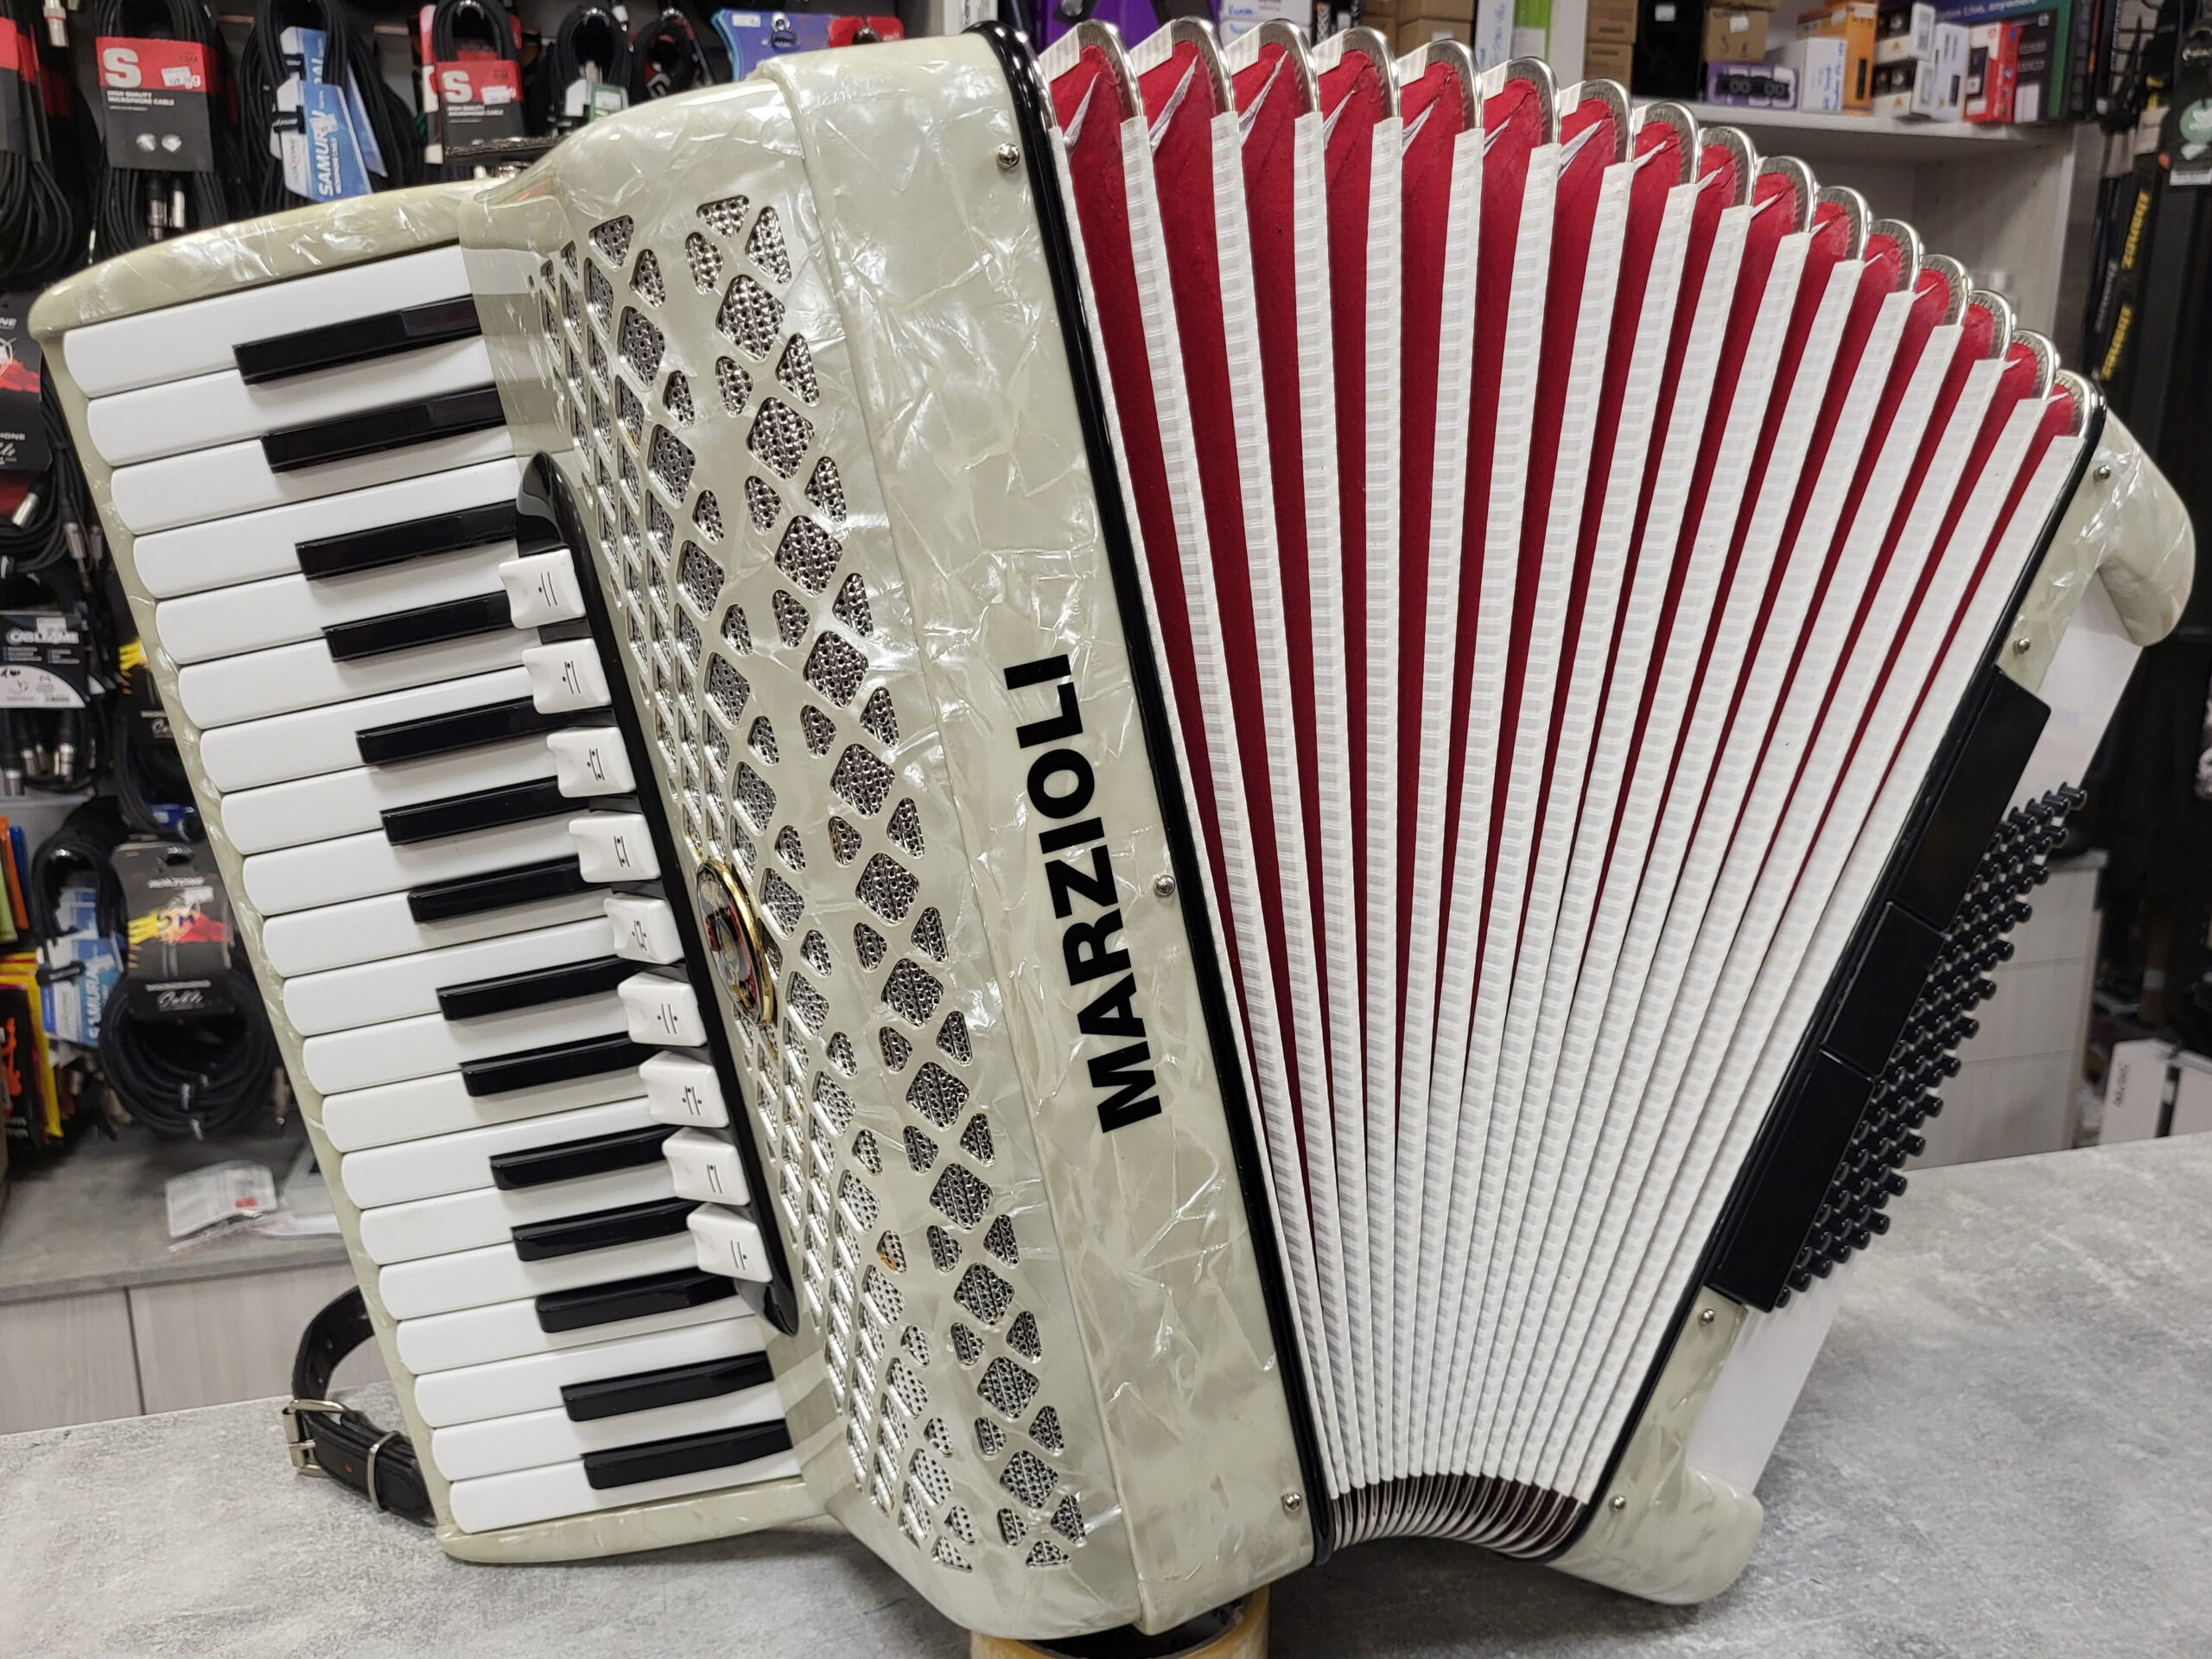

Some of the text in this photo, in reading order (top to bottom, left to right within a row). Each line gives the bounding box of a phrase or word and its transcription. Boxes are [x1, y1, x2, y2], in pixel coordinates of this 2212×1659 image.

[103, 48, 142, 88] S
[442, 70, 474, 104] S
[309, 109, 334, 197] SAMURI
[1003, 653, 1162, 1134] MARZIOLI
